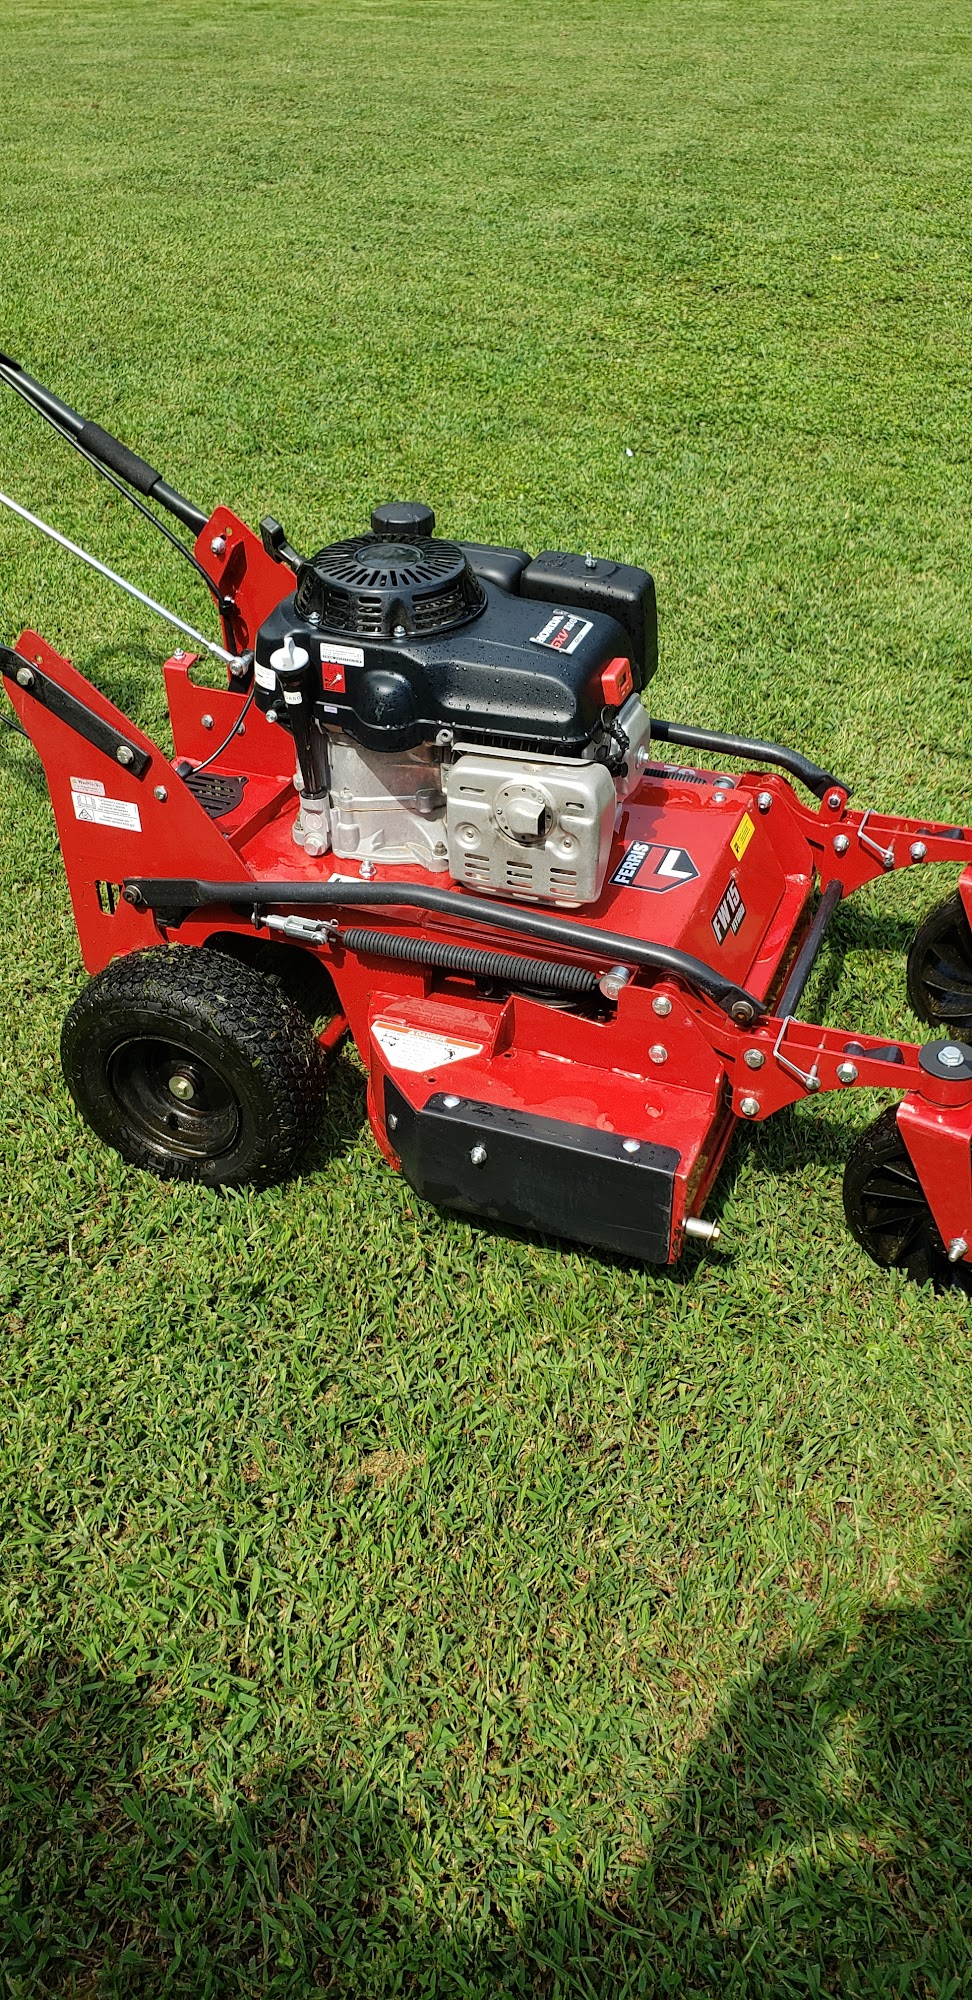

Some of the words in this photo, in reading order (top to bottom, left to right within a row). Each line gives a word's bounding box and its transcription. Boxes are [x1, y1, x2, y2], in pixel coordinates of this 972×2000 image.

[536, 615, 565, 643] HONDA
[550, 628, 569, 648] GXV
[614, 842, 649, 884] FERRIS
[713, 880, 740, 942] FW15
